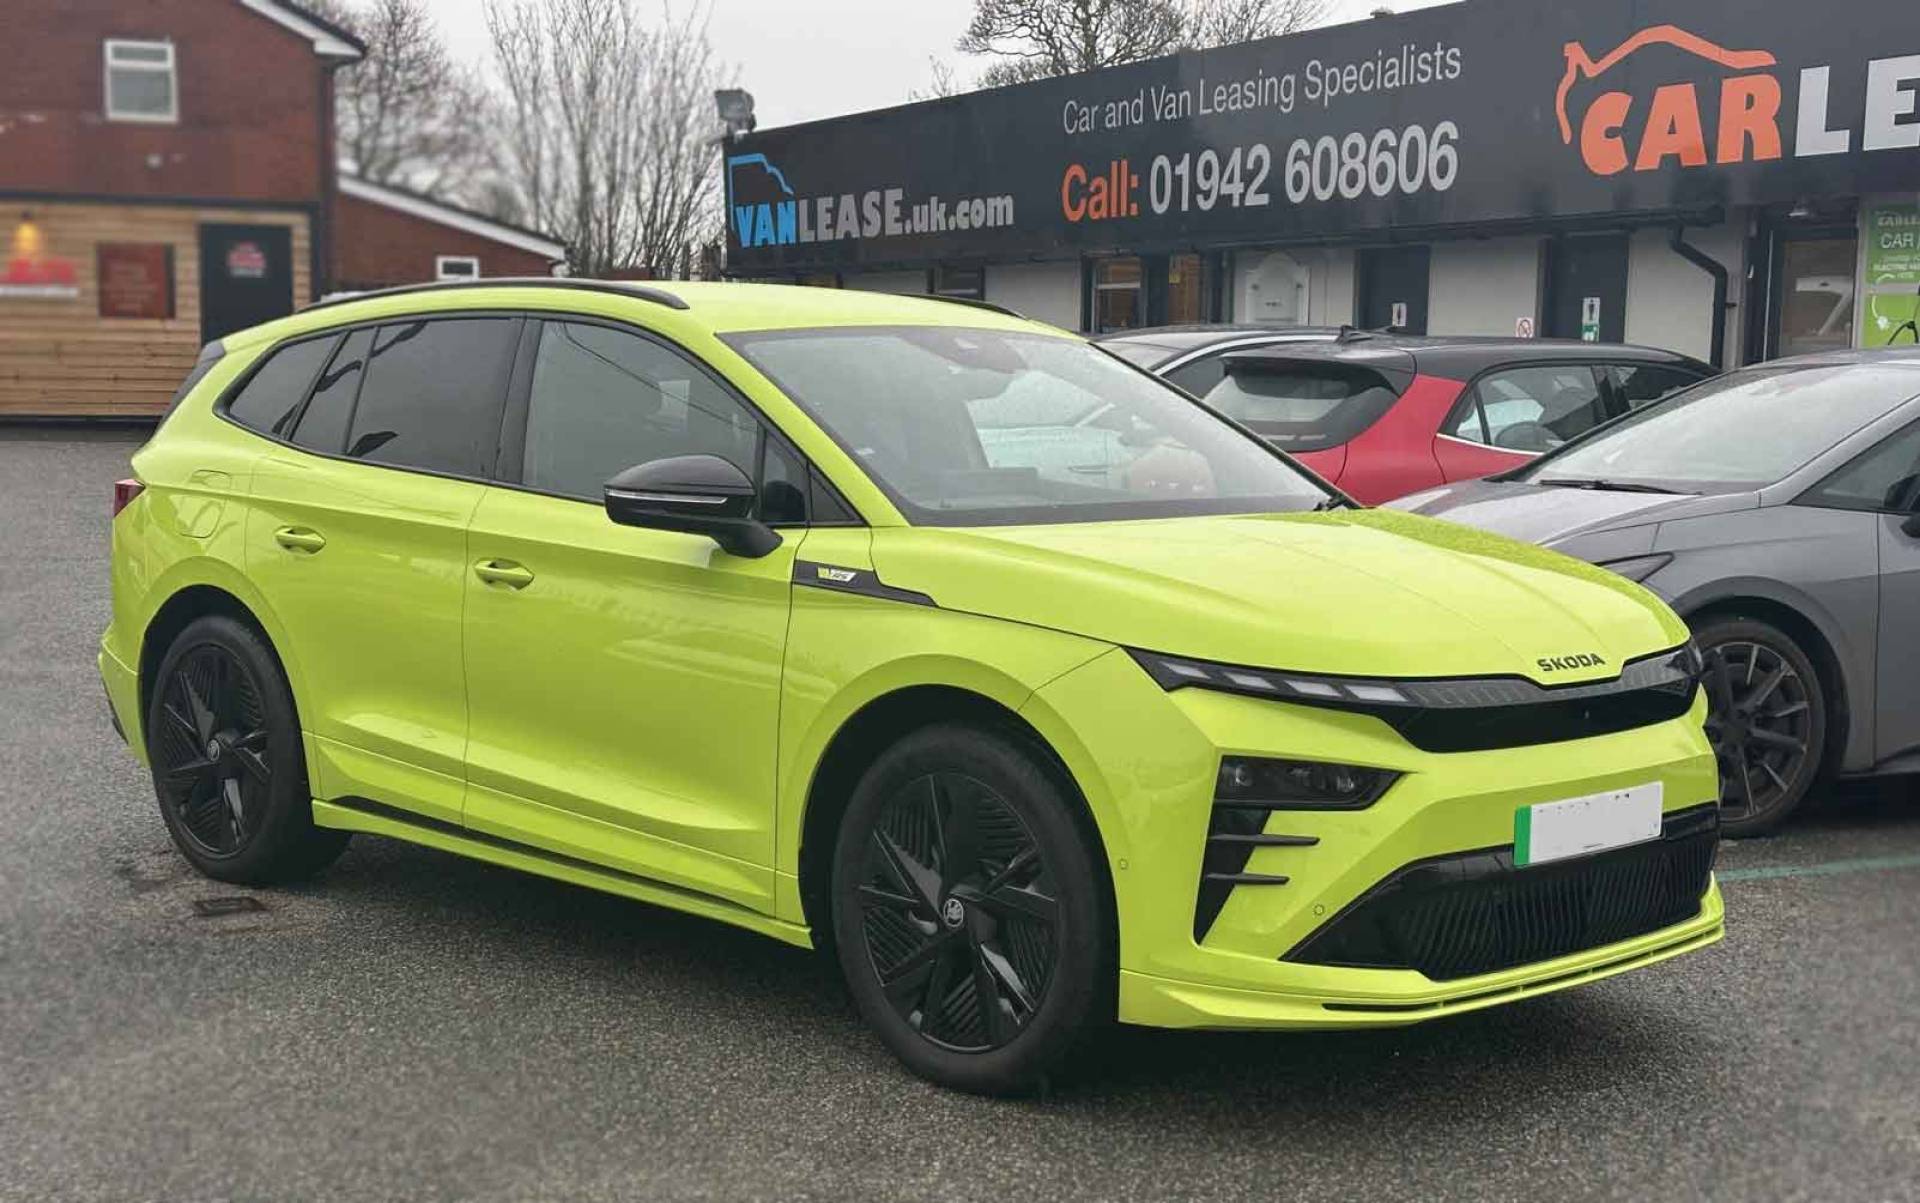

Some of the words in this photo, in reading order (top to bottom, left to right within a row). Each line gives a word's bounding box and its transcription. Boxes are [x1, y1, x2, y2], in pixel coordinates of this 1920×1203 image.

[1063, 100, 1098, 135] Car
[1104, 89, 1145, 129] and
[1149, 85, 1191, 122] Van
[1199, 69, 1297, 115] Leasing
[1304, 42, 1462, 106] Specialists
[1061, 159, 1140, 222] Call:
[1149, 143, 1271, 214] 01942
[1284, 120, 1459, 205] 608606
[1880, 232, 1915, 249] CAR
